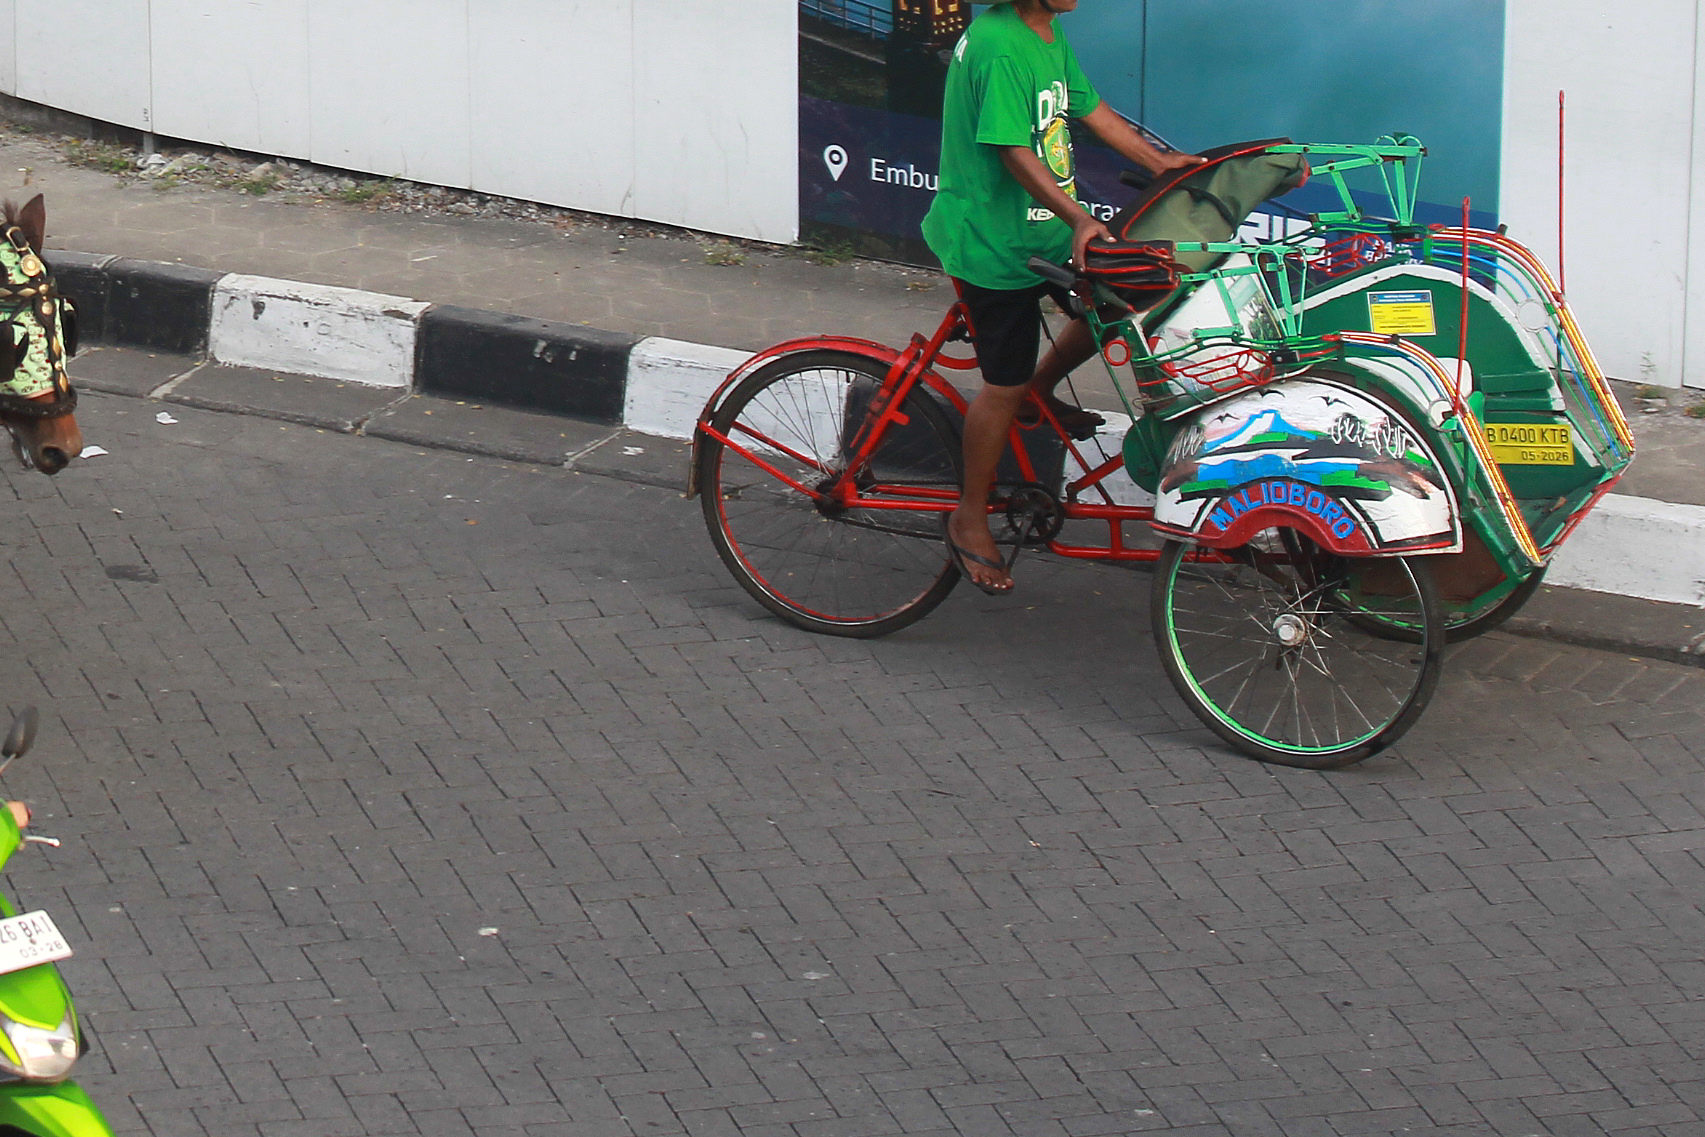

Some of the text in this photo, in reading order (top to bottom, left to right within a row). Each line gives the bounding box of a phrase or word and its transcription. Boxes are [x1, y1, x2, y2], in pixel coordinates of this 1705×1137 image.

[1500, 428, 1536, 443] 0400
[1540, 428, 1569, 444] KTB
[1521, 451, 1569, 462] 05-2026
[1209, 480, 1356, 539] MALIOBORO
